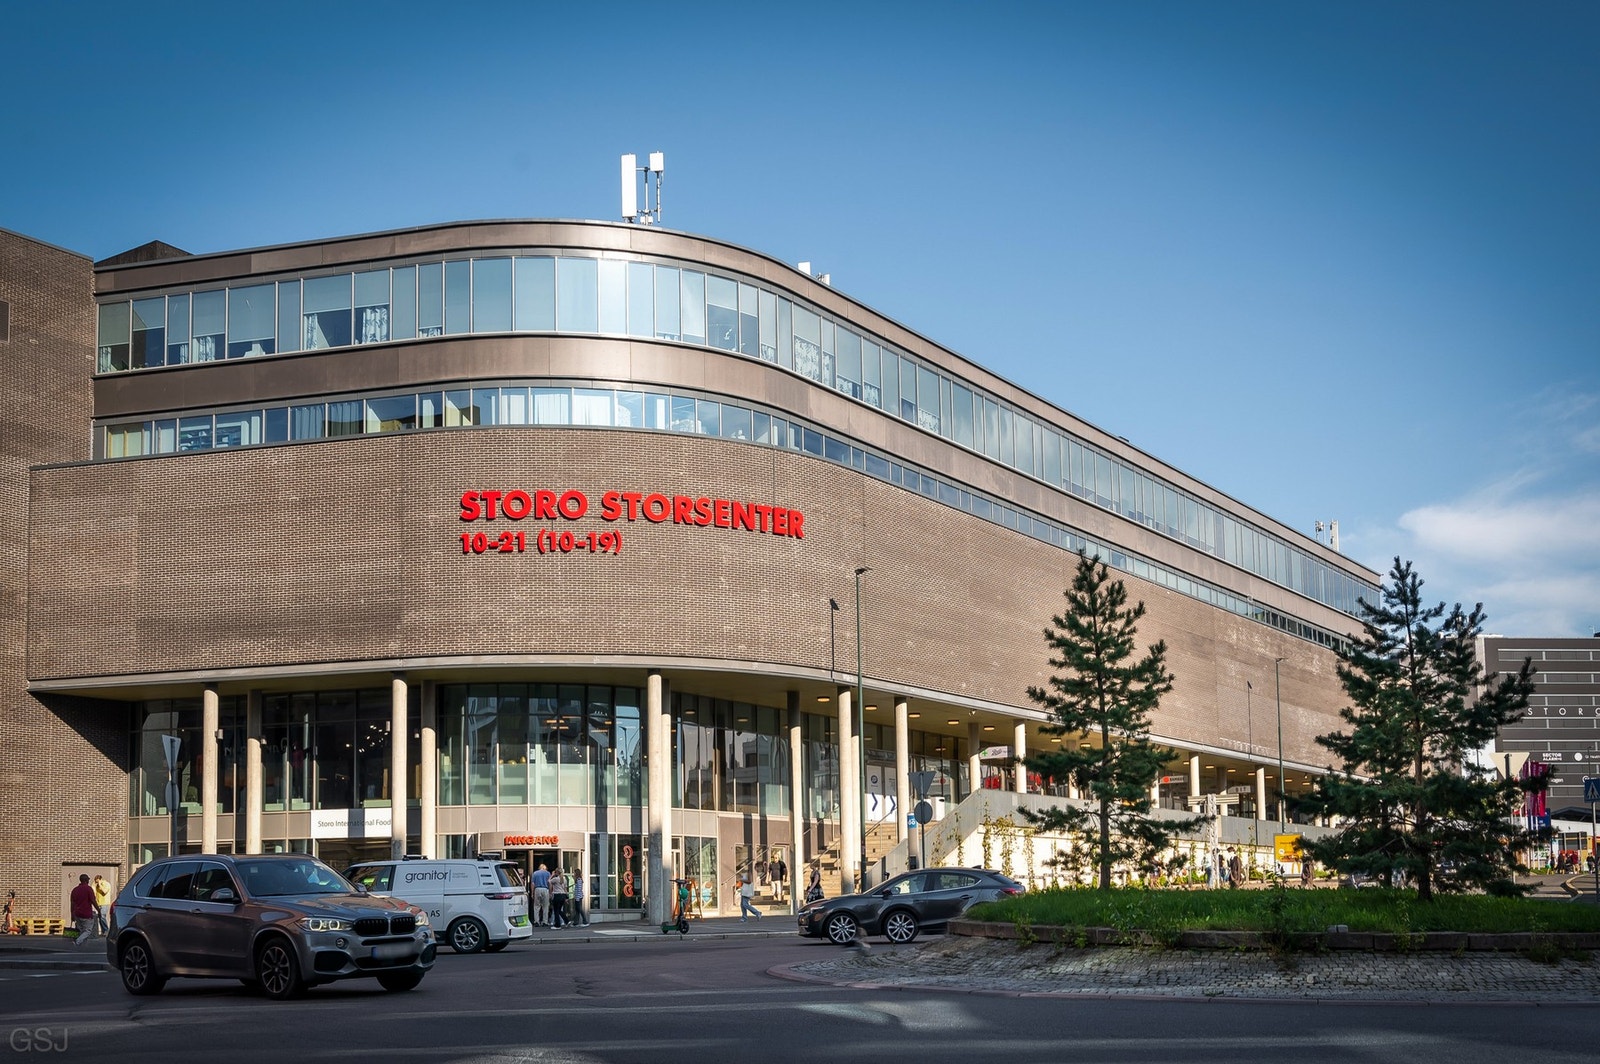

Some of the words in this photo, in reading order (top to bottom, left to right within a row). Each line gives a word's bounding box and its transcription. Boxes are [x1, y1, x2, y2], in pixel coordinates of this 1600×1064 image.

[459, 489, 589, 521] STORO
[600, 489, 805, 539] STORSENTER
[460, 530, 526, 555] 10-21
[537, 527, 623, 556] (10-19)
[318, 820, 335, 828] Storo
[336, 819, 375, 827] International
[376, 818, 392, 826] Food
[504, 835, 559, 846] INNGANG
[405, 870, 449, 883] granitor
[430, 910, 441, 918] AS
